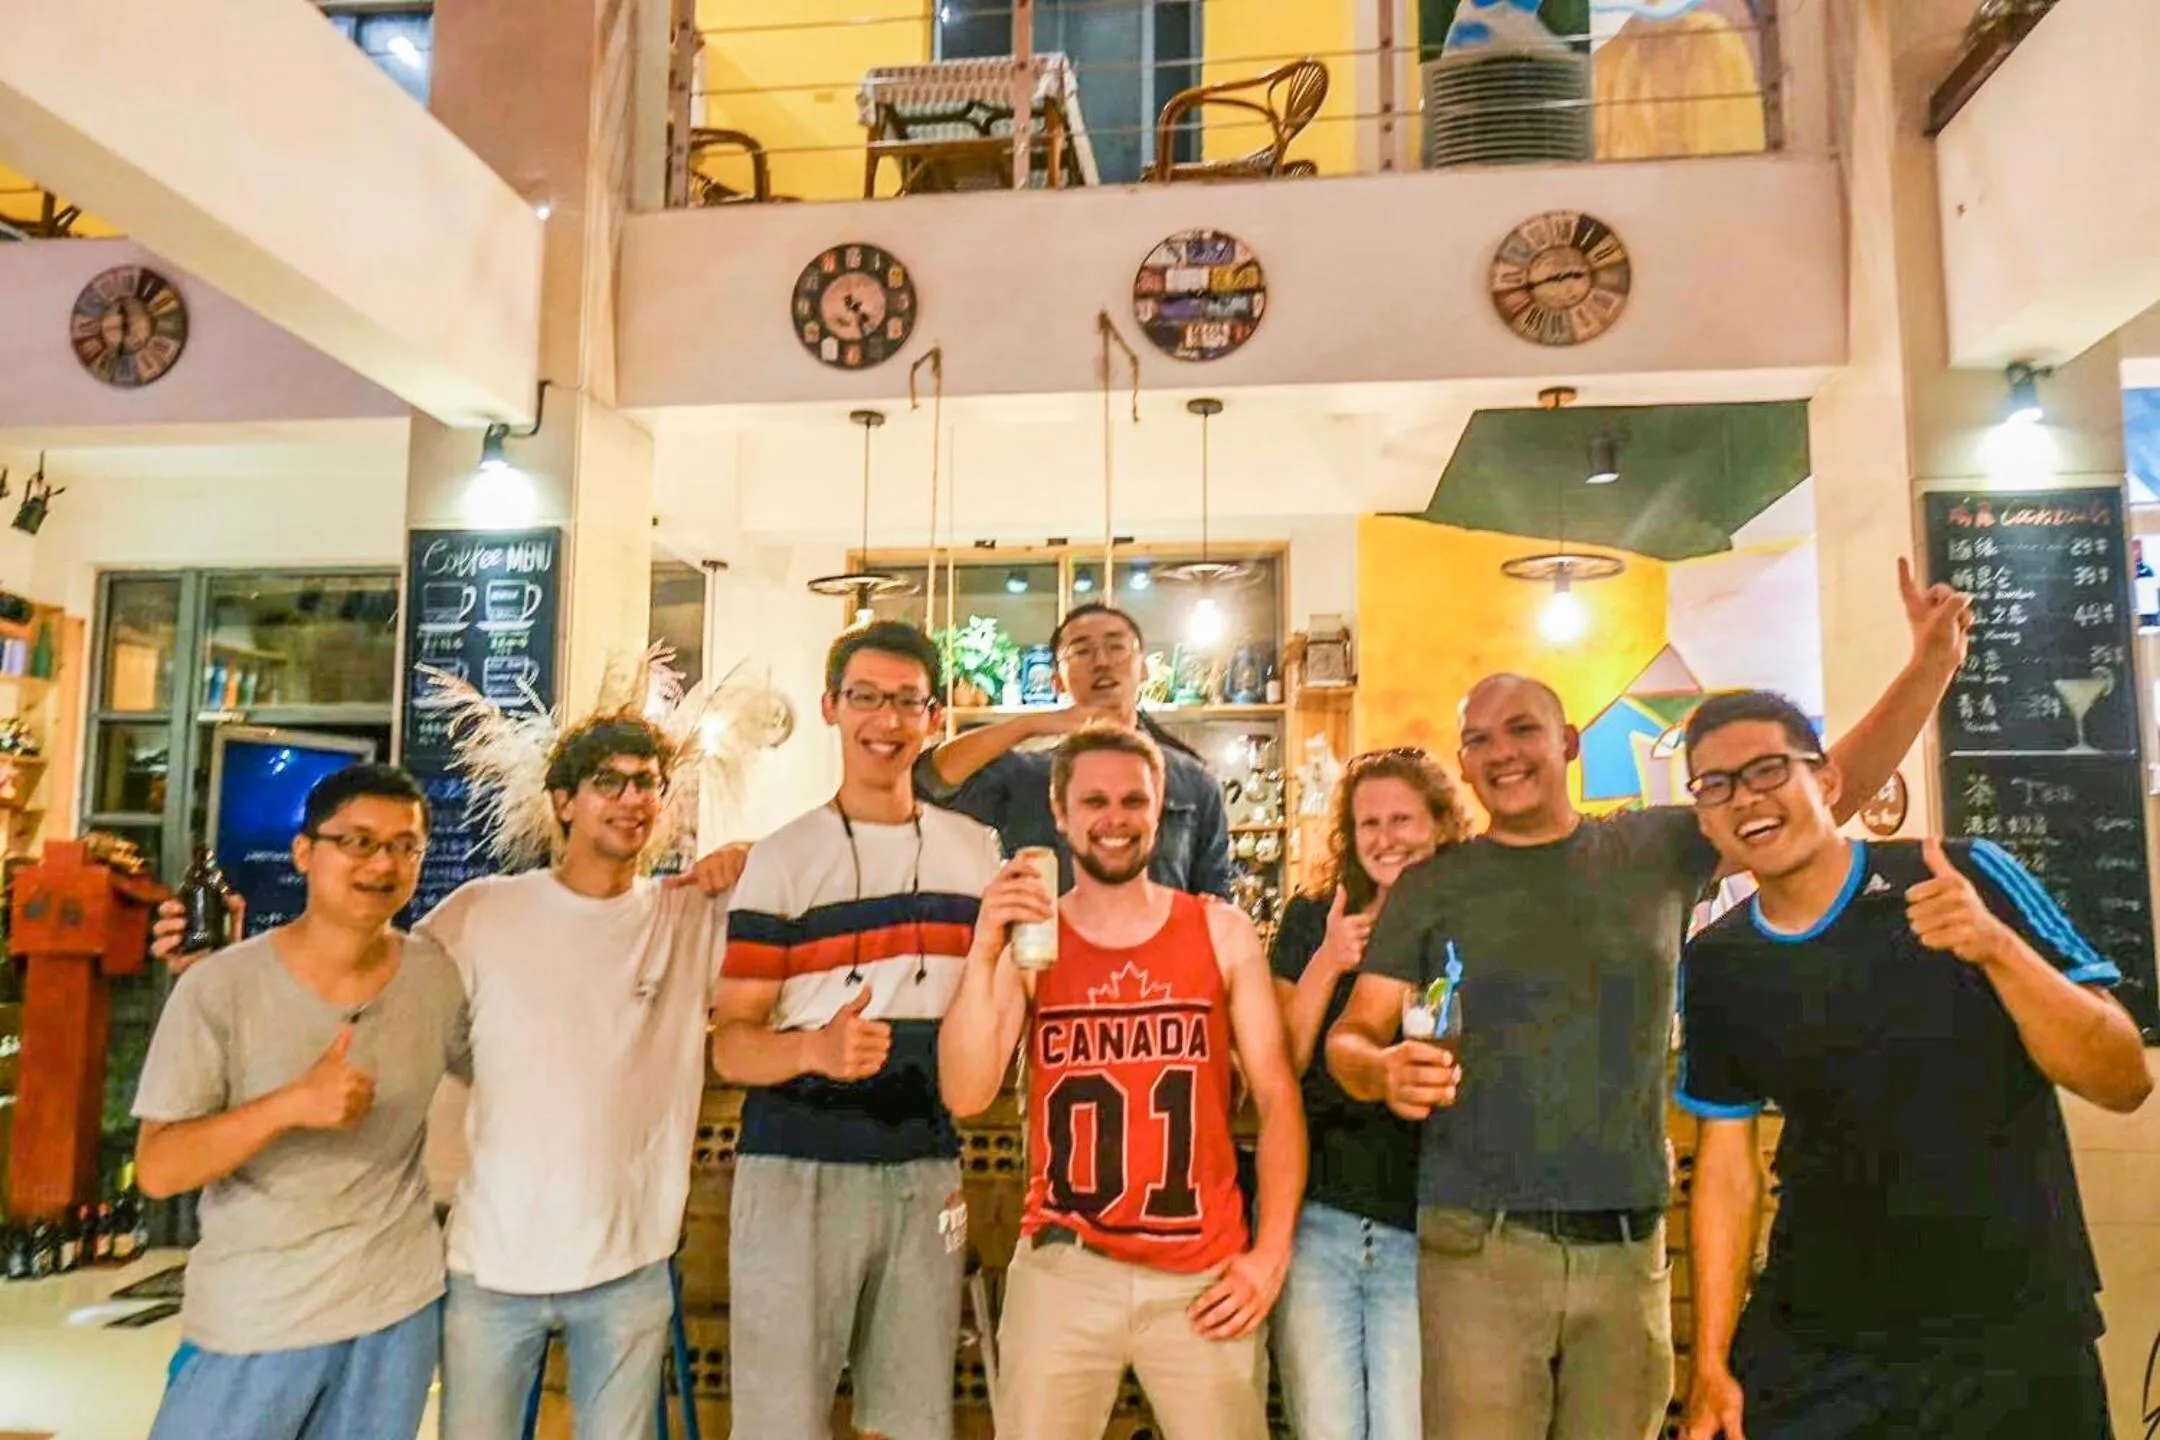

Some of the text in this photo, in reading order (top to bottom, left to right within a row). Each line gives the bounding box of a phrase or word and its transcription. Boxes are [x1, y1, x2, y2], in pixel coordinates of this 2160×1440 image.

[423, 539, 505, 577] Coffee
[1039, 1013, 1210, 1069] CANADA
[1044, 1065, 1203, 1222] 01
